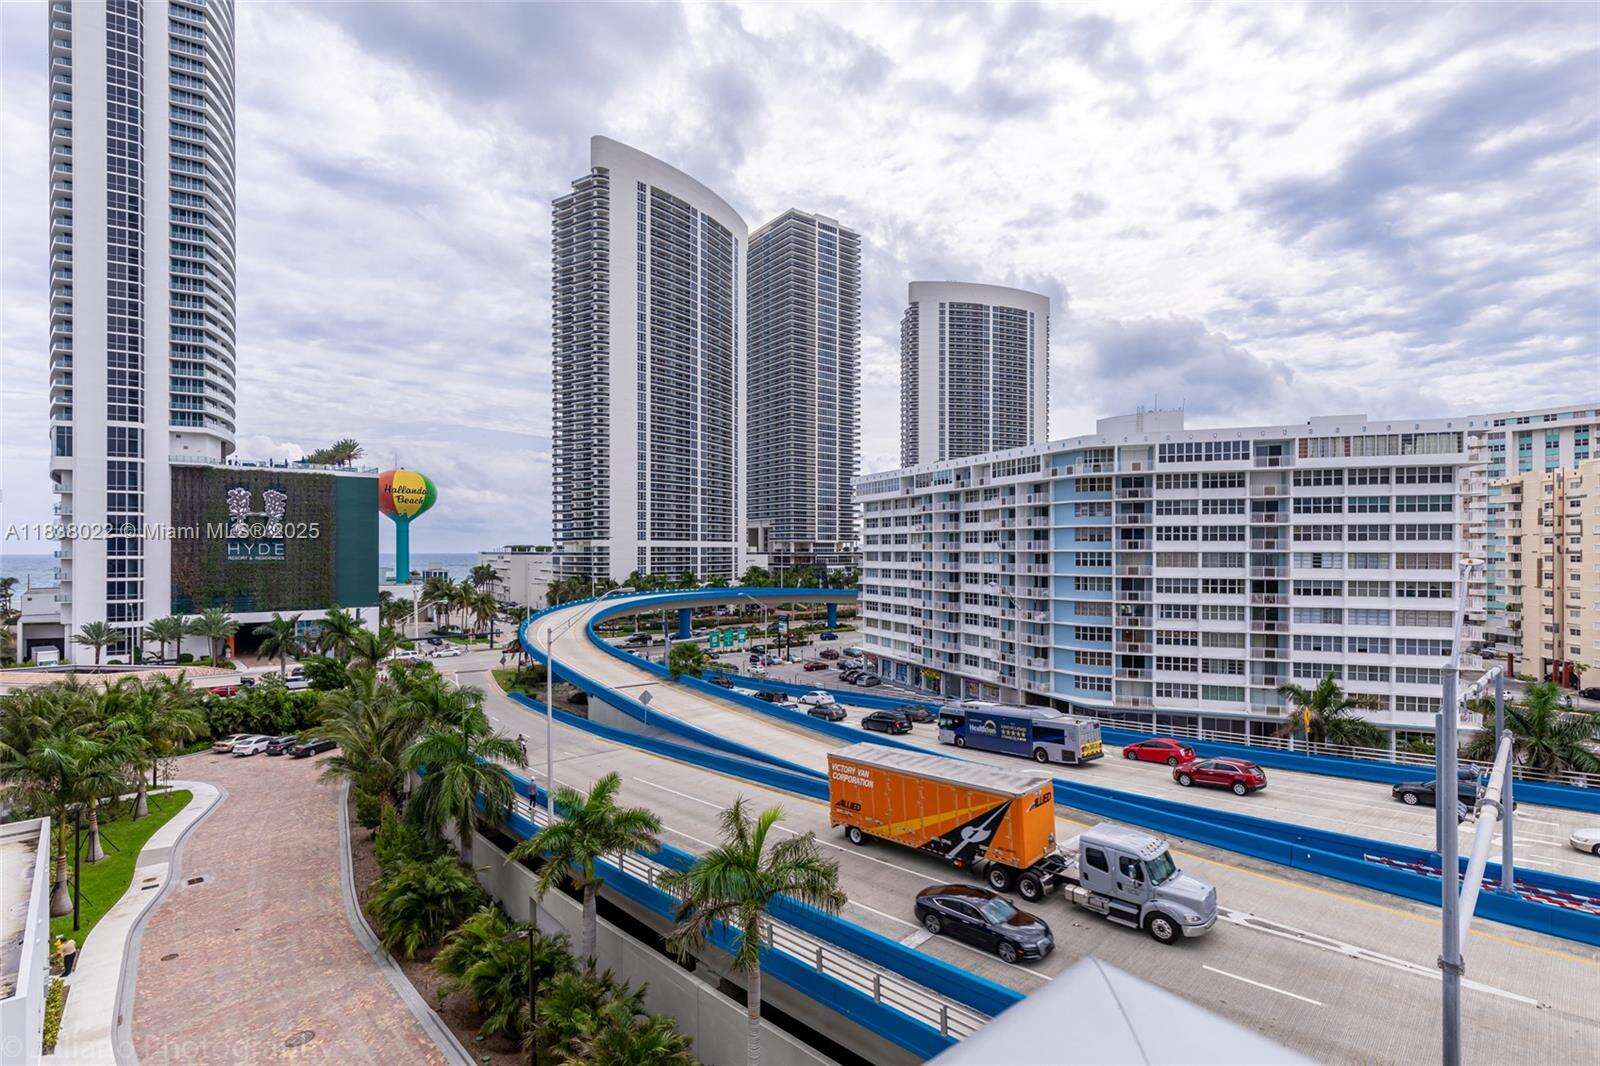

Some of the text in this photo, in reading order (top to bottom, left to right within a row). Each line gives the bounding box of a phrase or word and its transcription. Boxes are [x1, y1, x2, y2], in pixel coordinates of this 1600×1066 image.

[384, 483, 432, 495] Hallanda
[396, 494, 423, 504] Beach
[227, 543, 285, 555] HYDE
[831, 763, 870, 778] VICTORY VAN
[832, 771, 874, 788] CORPORATION
[835, 799, 862, 812] ALLIED
[1028, 791, 1052, 812] ALLIED
